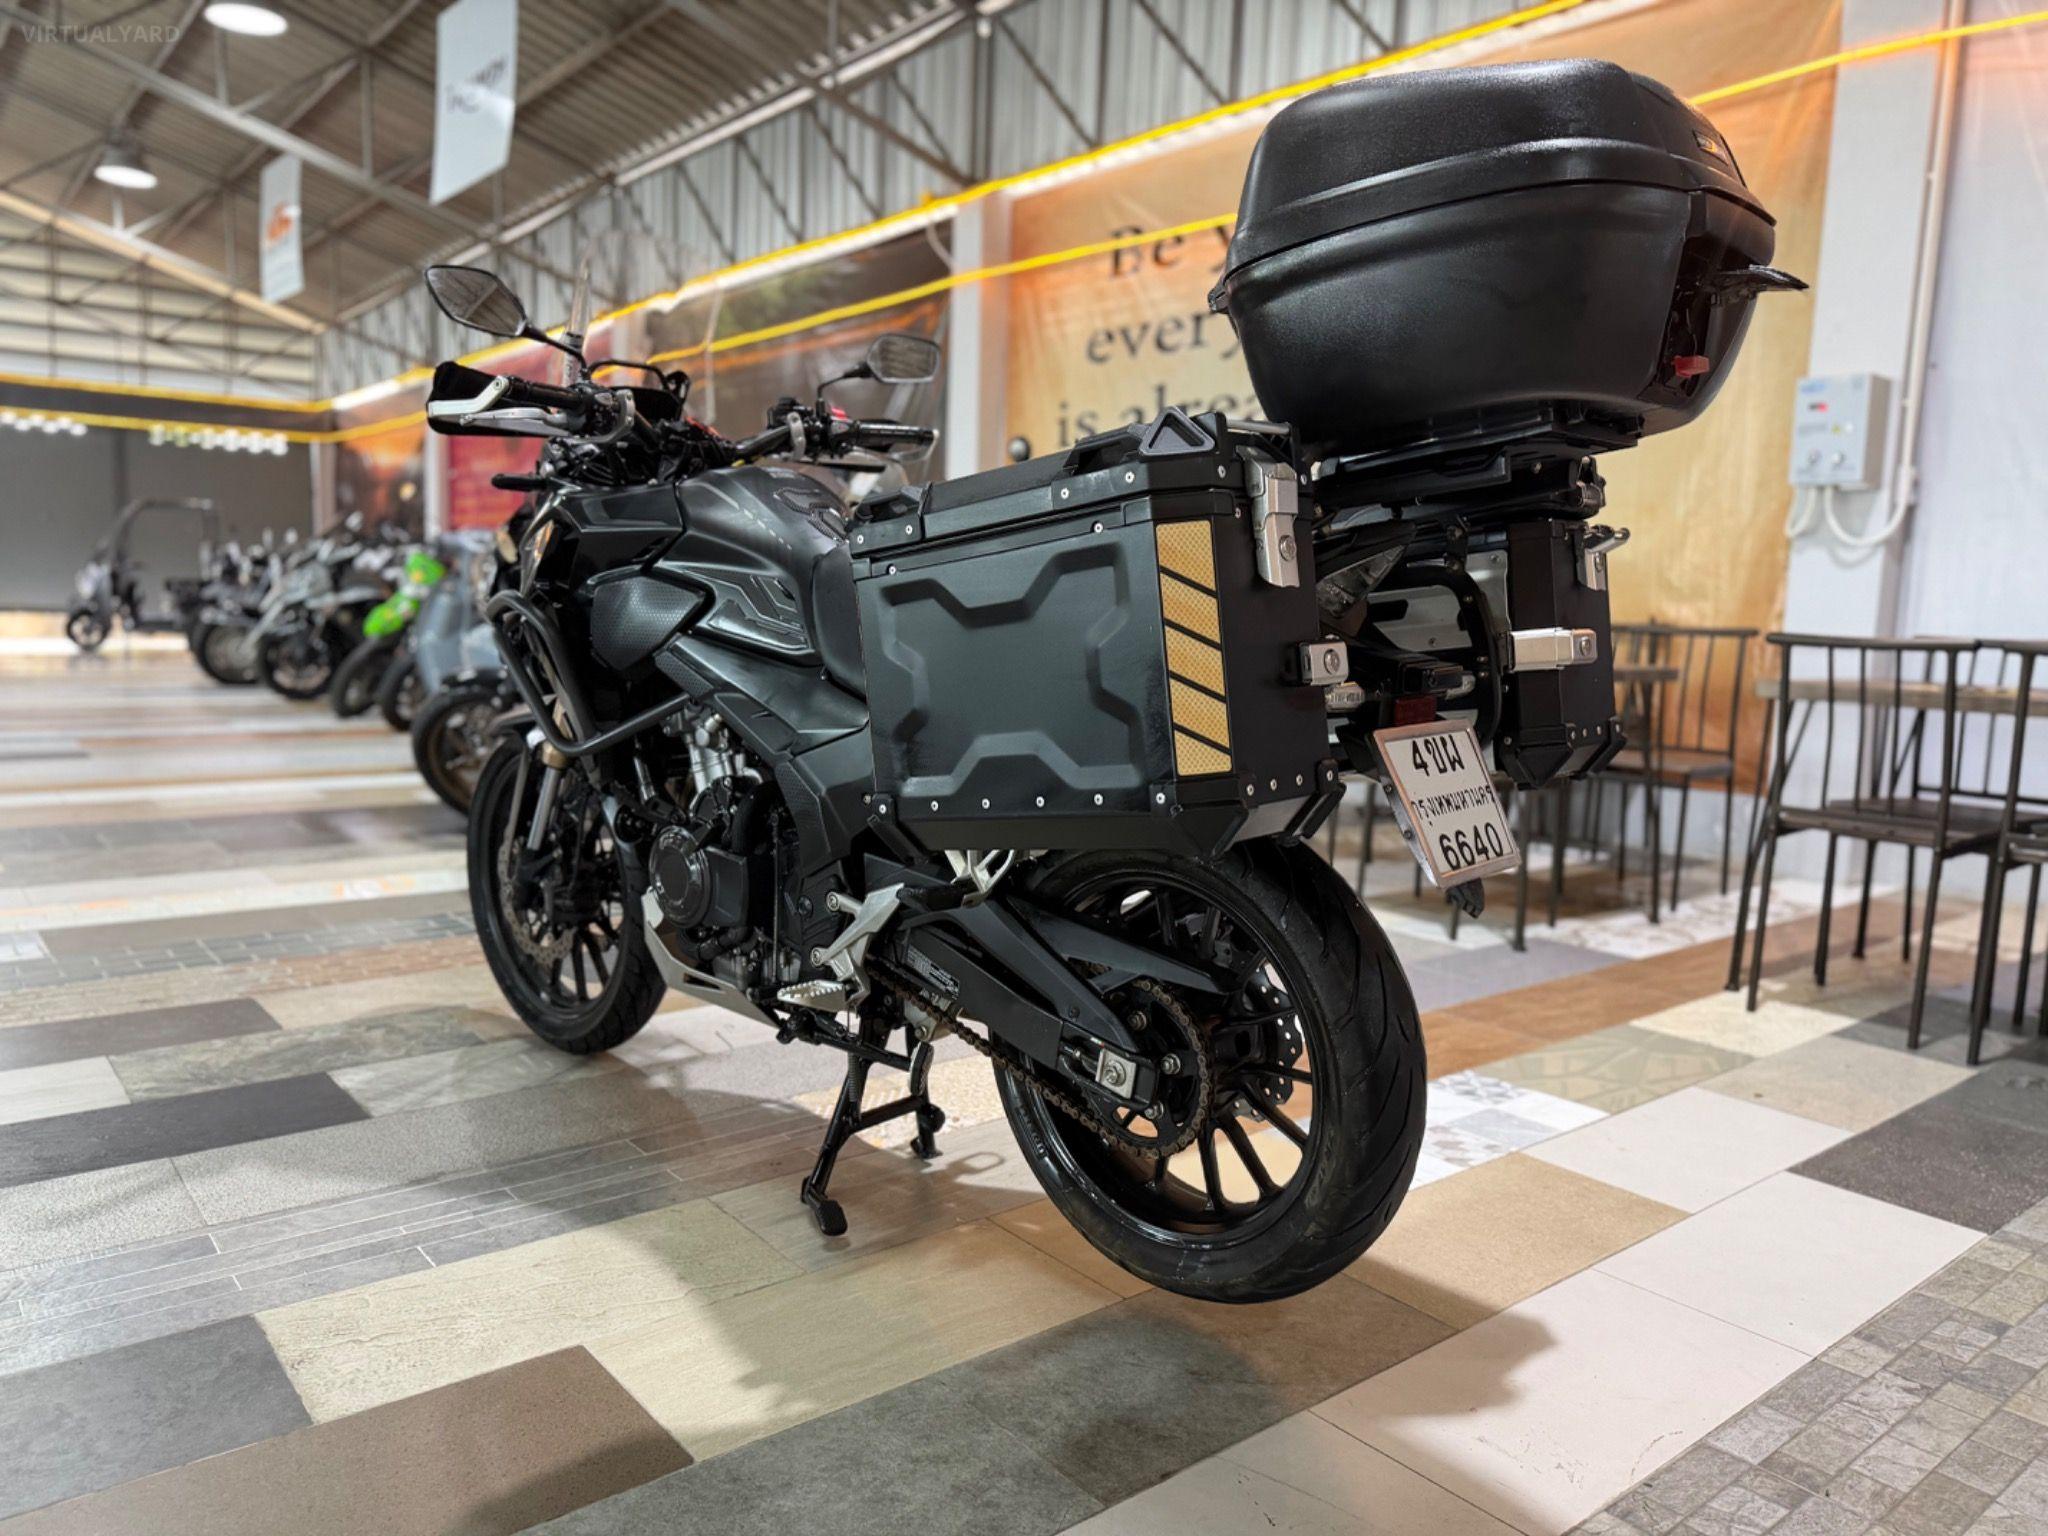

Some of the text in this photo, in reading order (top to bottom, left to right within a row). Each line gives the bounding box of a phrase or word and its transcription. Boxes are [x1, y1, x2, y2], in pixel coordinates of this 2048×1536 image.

[1109, 225, 1184, 277] Be
[1057, 401, 1098, 447] is
[1438, 822, 1504, 871] 6640
